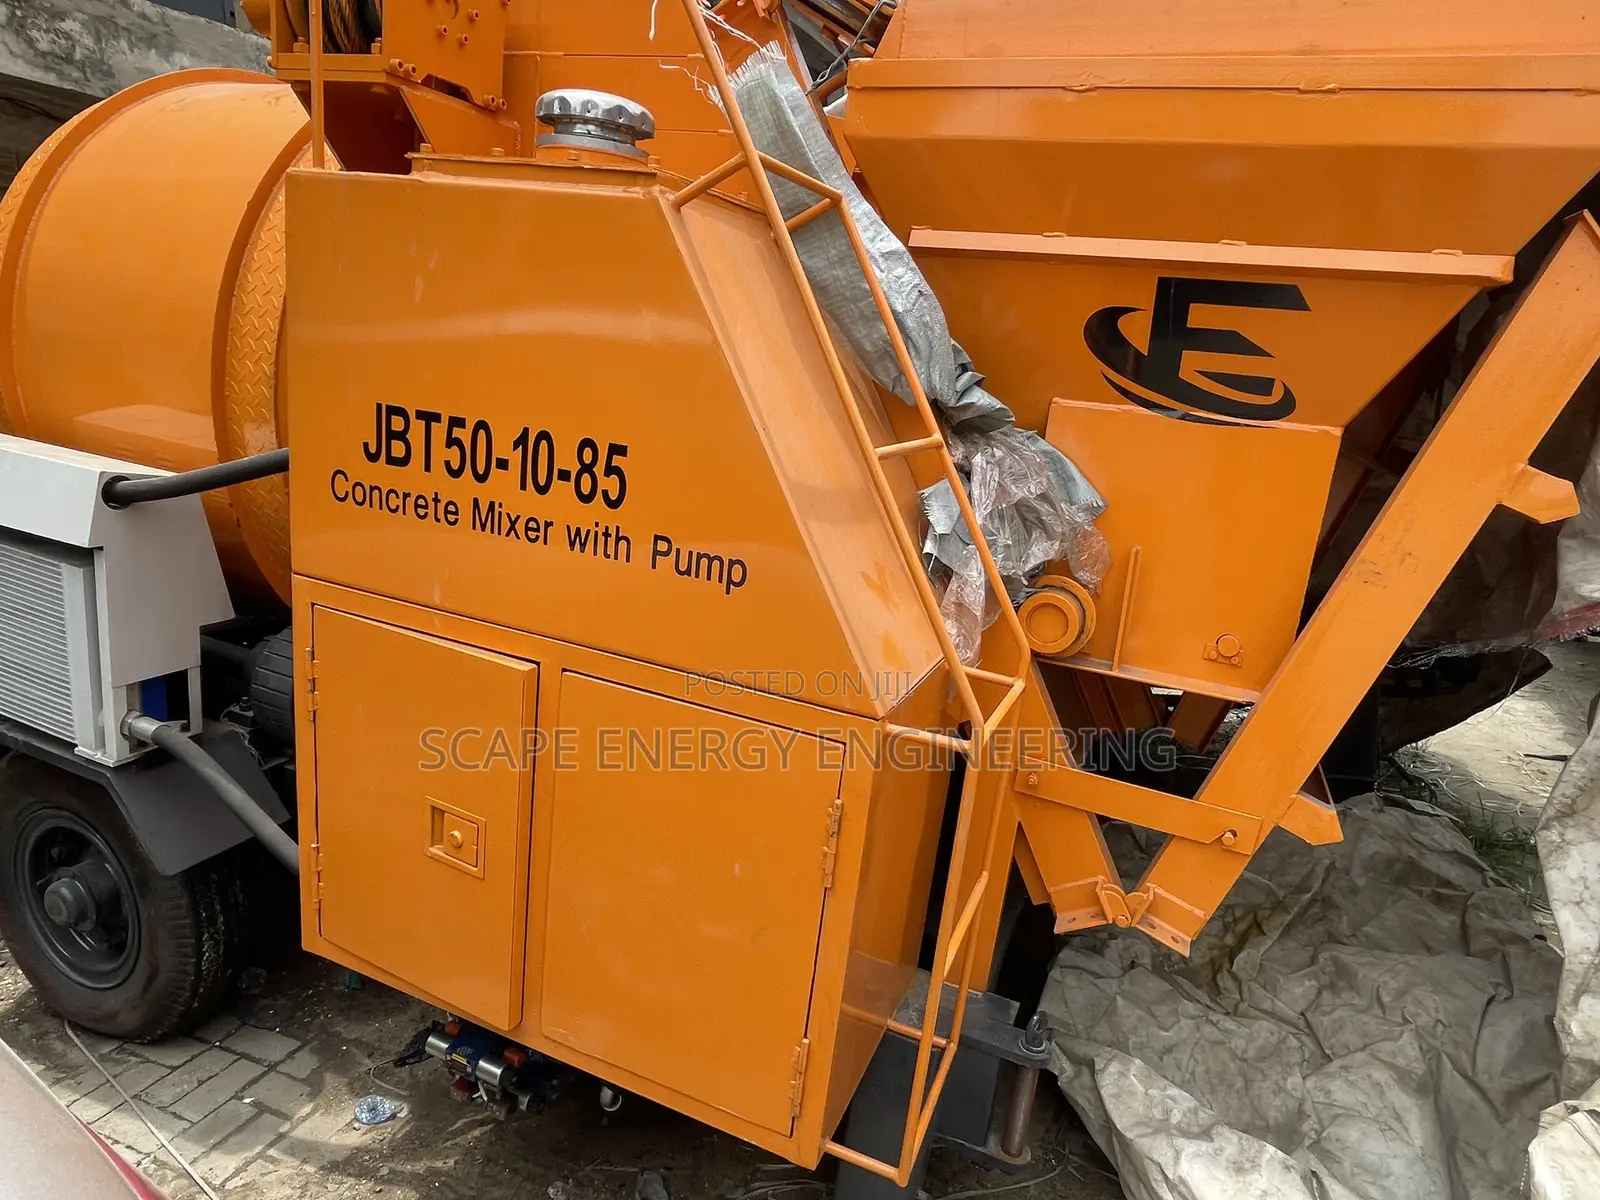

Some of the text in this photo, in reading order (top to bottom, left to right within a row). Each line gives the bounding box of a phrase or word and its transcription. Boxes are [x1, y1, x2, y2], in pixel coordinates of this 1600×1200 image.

[362, 402, 629, 510] JBT50-10-85
[329, 468, 749, 596] Concrete Mixer with Pump
